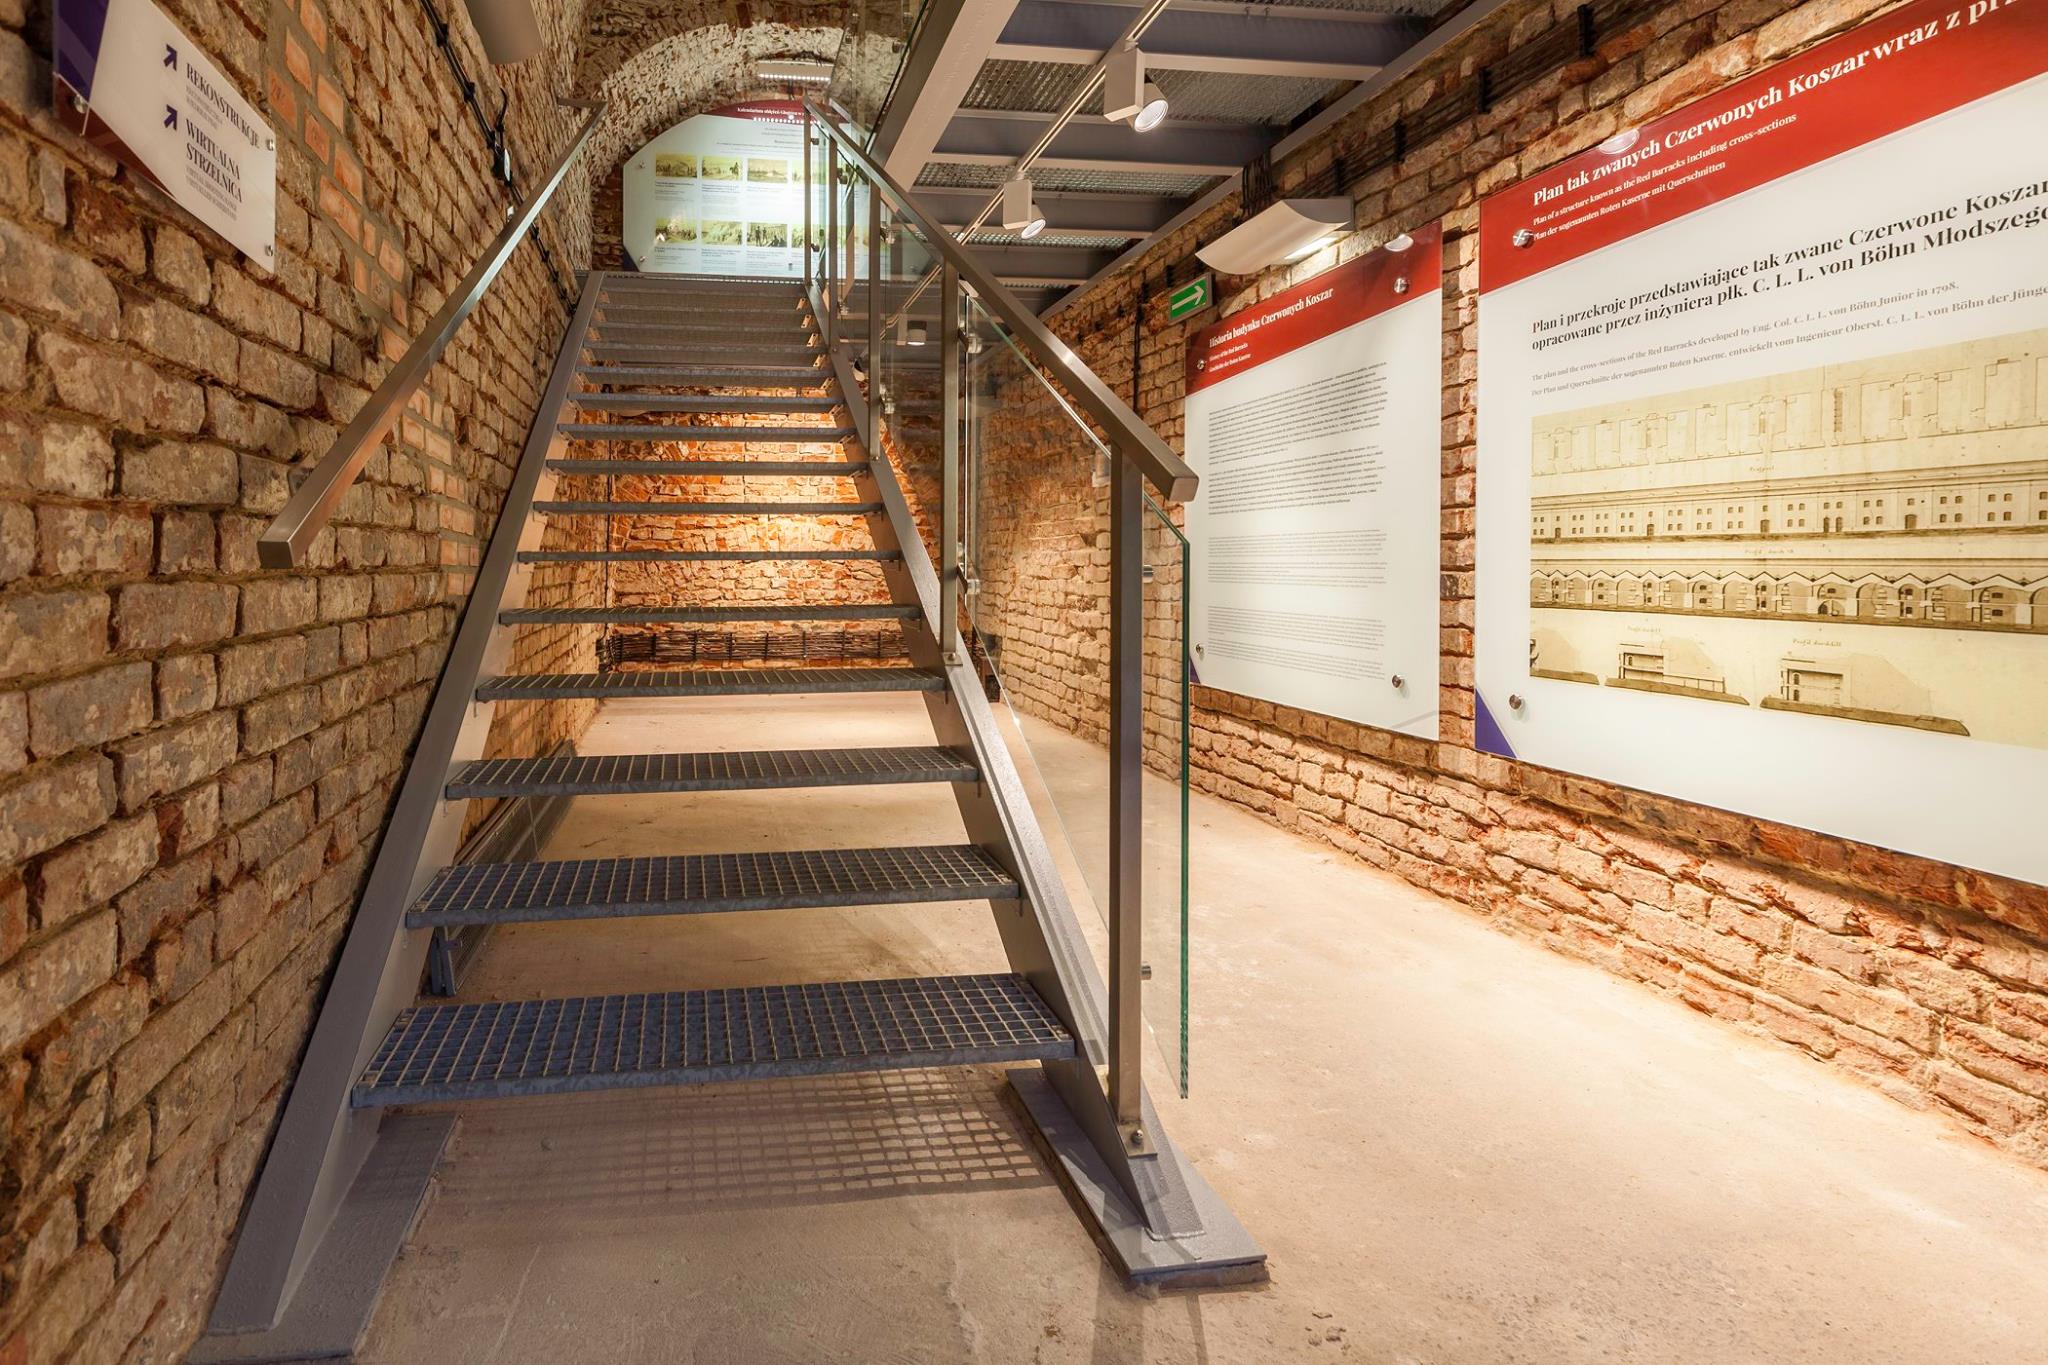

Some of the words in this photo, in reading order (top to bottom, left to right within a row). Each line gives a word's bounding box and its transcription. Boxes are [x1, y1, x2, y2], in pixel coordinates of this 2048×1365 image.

[186, 62, 260, 149] REKONSTRUKCJE
[1533, 184, 1564, 206] Plan
[1567, 170, 1590, 191] tak
[1592, 139, 1661, 182] zwanych
[1664, 86, 1782, 149] Czerwonych
[1788, 50, 1870, 97] Koszar
[1872, 20, 1938, 60] wraz
[1946, 10, 1960, 30] z
[185, 118, 240, 181] WIRTUALNA
[186, 142, 242, 203] STRZELNICA
[1533, 214, 1547, 225] Plan
[1547, 211, 1555, 220] of
[1559, 197, 1590, 216] structure
[1590, 189, 1614, 204] known
[1614, 185, 1623, 193] as
[1623, 179, 1636, 189] the
[1636, 172, 1651, 184] Red
[1651, 158, 1686, 178] Barracks
[1687, 140, 1728, 165] including
[1729, 113, 1797, 147] cross-sections
[1547, 227, 1558, 236] der
[1559, 211, 1600, 231] sogenannten
[1600, 203, 1621, 215] Roten
[1621, 190, 1651, 208] Kaserne
[1651, 184, 1666, 195] mit
[1667, 161, 1726, 190] Querschnitten
[1532, 318, 1557, 333] Plan
[1560, 314, 1564, 326] i
[1567, 298, 1626, 327] przekroje
[1629, 265, 1749, 310] przedstawiające
[1753, 253, 1780, 273] tak
[1784, 238, 1844, 265] zwane
[1849, 206, 1958, 246] Czerwone
[1532, 323, 1603, 351] opracowane
[1605, 313, 1642, 334] przez
[1644, 295, 1713, 322] inżyniera
[1717, 284, 1748, 306] płk.
[1753, 278, 1771, 294] C.
[1776, 273, 1792, 288] L.
[1798, 267, 1814, 283] L.
[1819, 258, 1854, 276] von
[1861, 242, 1915, 267] Böhn
[1923, 206, 2048, 251] Młodszego
[1209, 329, 1233, 348] Historia
[1232, 319, 1260, 338] budynku
[1261, 299, 1304, 326] Czerwonych
[1305, 288, 1334, 308] Koszar
[1611, 372, 1622, 380] der
[1669, 358, 1692, 369] Roten
[1728, 341, 1773, 357] entwickelt
[1774, 337, 1794, 348] vom
[1796, 328, 1843, 344] Ingenieur
[1846, 319, 1884, 333] Oberst.
[1886, 316, 1898, 325] C.
[1901, 313, 1911, 322] L.
[1914, 311, 1925, 320] L.
[1927, 306, 1949, 317] von
[1952, 298, 1984, 313] Böhn
[1987, 294, 2010, 305] der
[1627, 352, 1636, 360] of
[1636, 350, 1647, 358] the
[1648, 345, 1662, 356] Red
[1663, 339, 1698, 353] Barracks
[1698, 328, 1738, 346] developed
[1741, 327, 1750, 337] by
[1752, 323, 1771, 333] Eng.
[1774, 318, 1792, 328] Col.
[1794, 316, 1804, 324] C.
[1806, 313, 1815, 321] L.
[1818, 311, 1827, 319] L.
[1829, 306, 1847, 316] von
[1849, 300, 1876, 312] Böhn
[1877, 291, 1914, 307] Junior
[1916, 288, 1928, 298] in
[1931, 281, 1959, 295] 1798.
